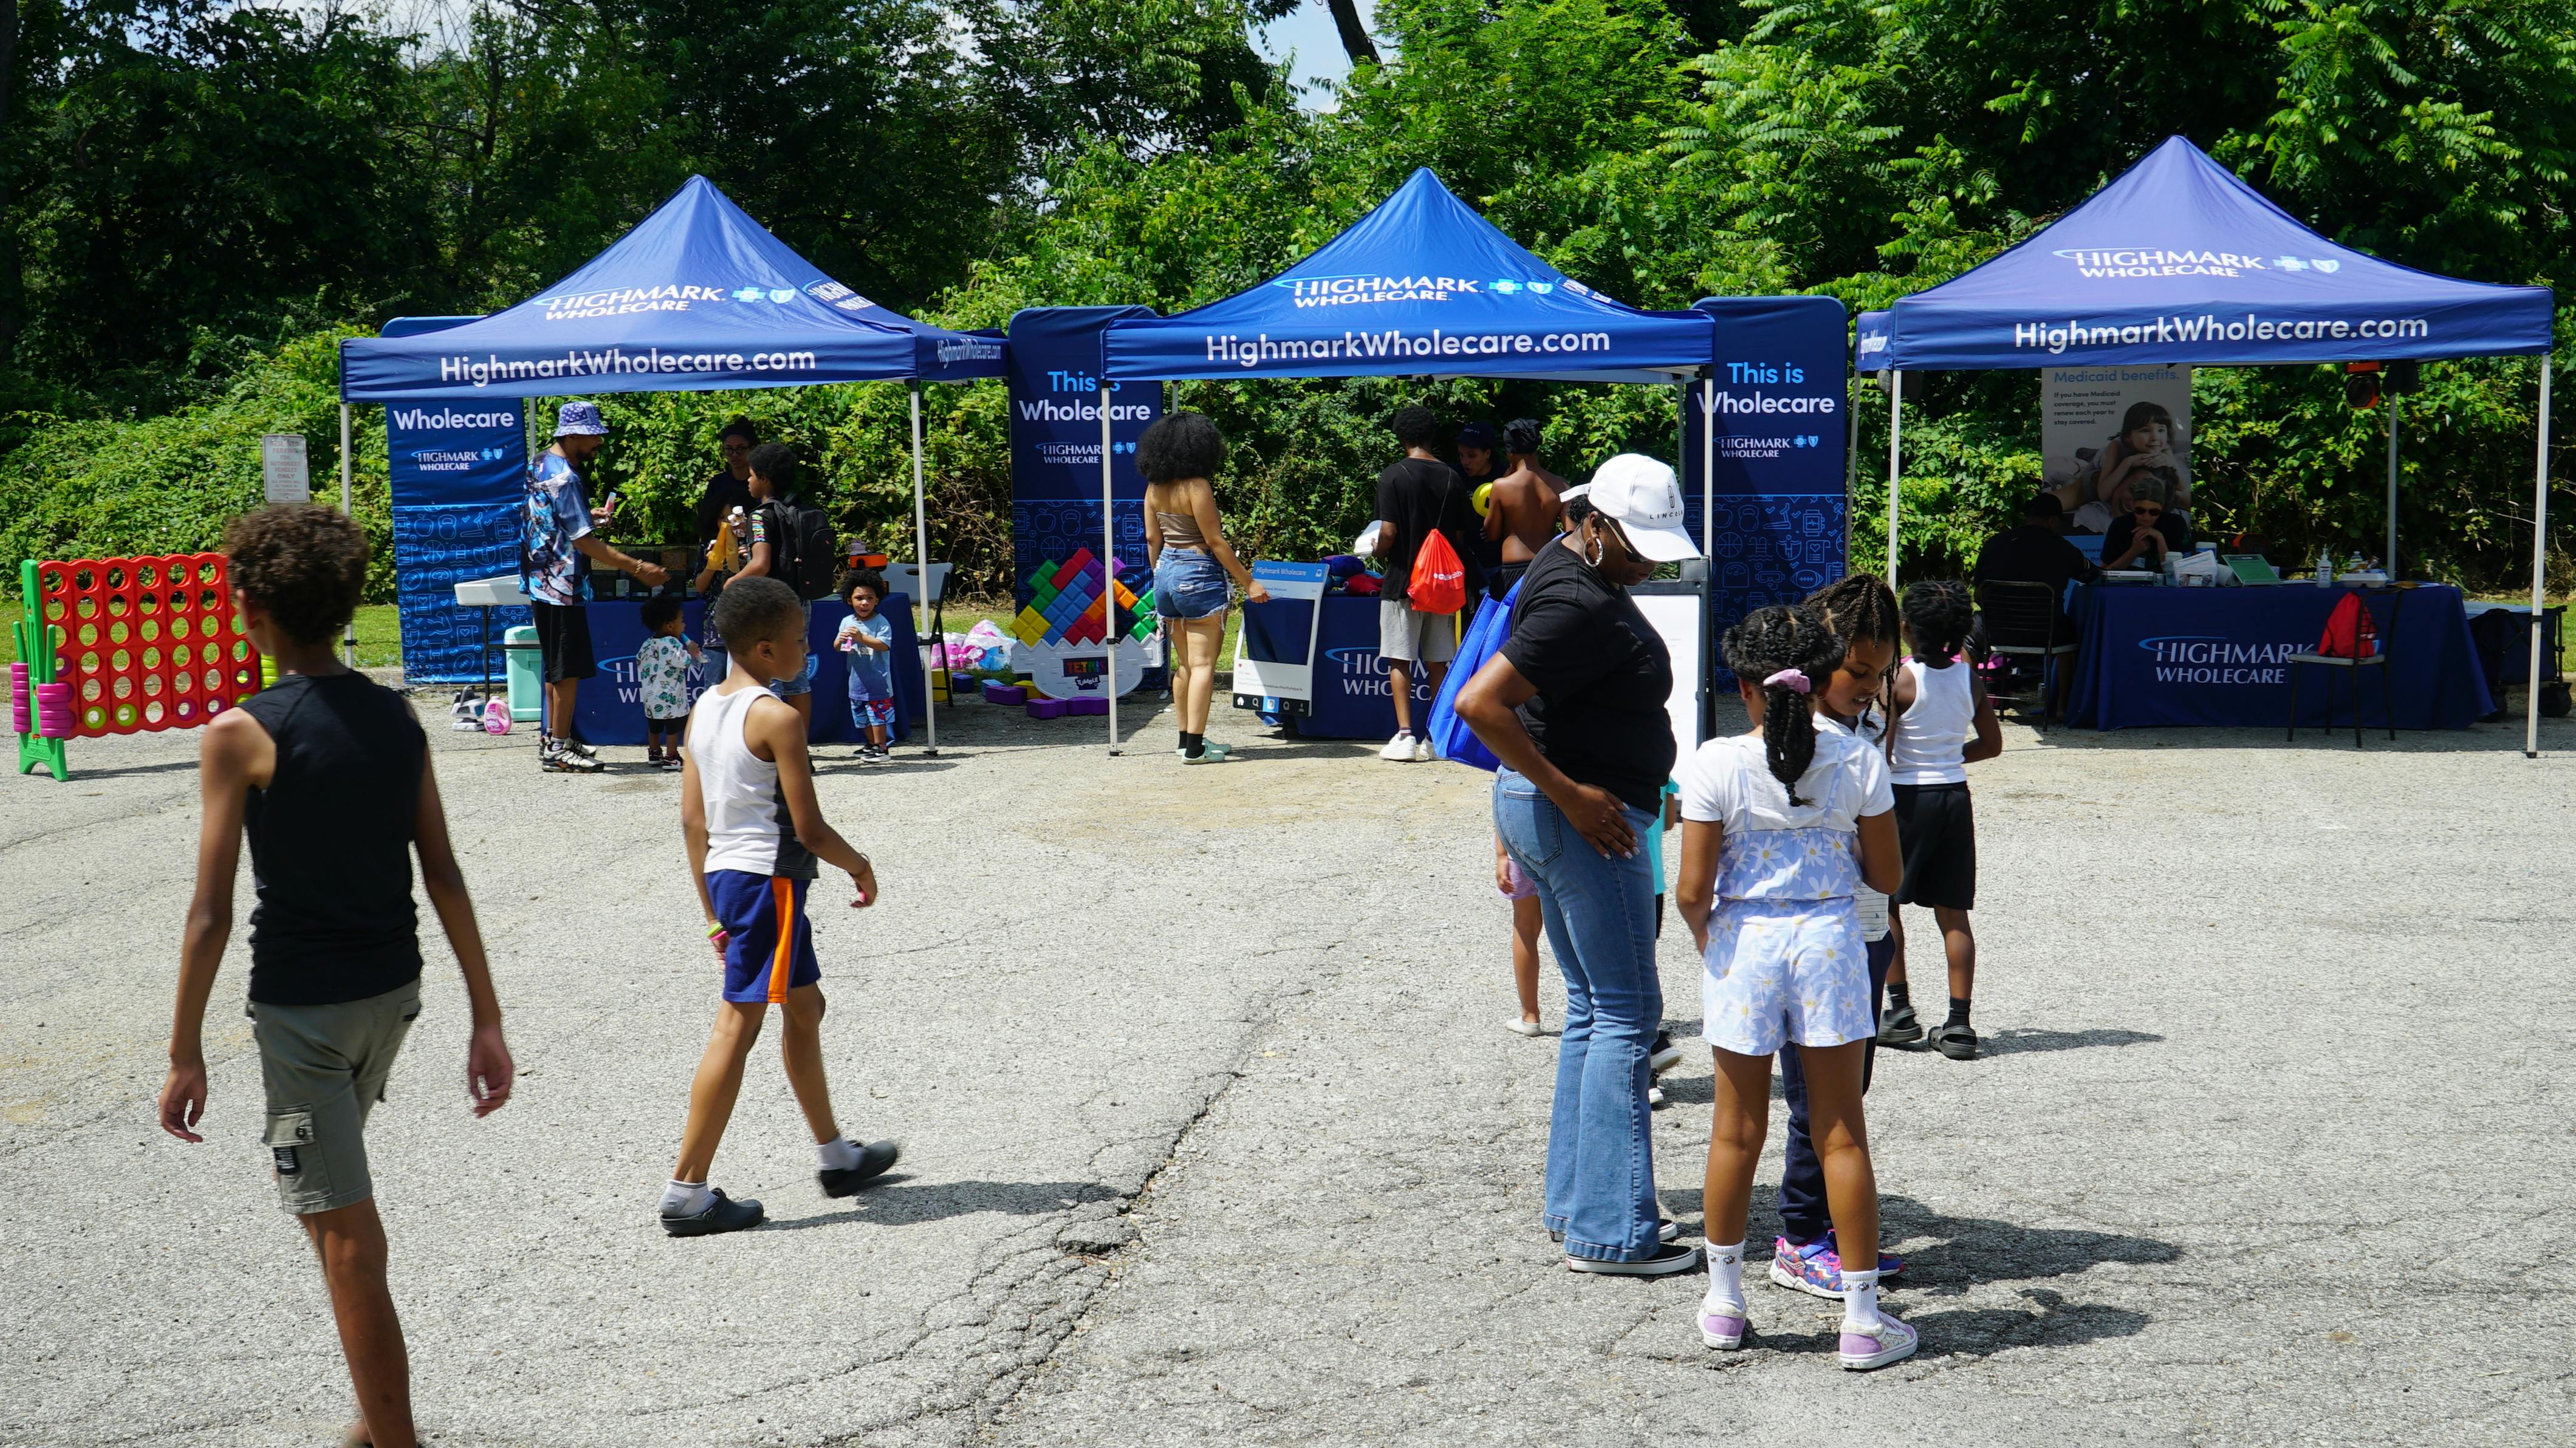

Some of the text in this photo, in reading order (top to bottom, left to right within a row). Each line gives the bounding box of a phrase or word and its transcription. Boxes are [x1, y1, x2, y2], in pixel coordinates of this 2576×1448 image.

[2075, 250, 2265, 269] HIGHMARK
[2080, 265, 2239, 278] WHOLECARE
[1295, 276, 1479, 296] HIGHMARK
[549, 284, 724, 311] HIGHMARK
[1295, 290, 1448, 308] WHOLECARE
[546, 300, 690, 320] WHOLECARE
[2015, 315, 2428, 354] HighmarkWholecare.com
[1207, 330, 1610, 367] HighmarkWholecare.com
[440, 347, 815, 388] HighmarkWholecare.com
[1727, 361, 1804, 383] This is
[2054, 369, 2180, 383] Medicaid benefits.
[1047, 371, 1096, 392] This
[1019, 399, 1151, 421] Wholecare
[1696, 391, 1835, 414] Wholecare
[393, 408, 515, 430] Wholecare
[1043, 445, 1103, 455] HIGHMAR
[1721, 438, 1790, 448] HIGHMARK
[418, 452, 479, 462] HIGHMARK
[1722, 449, 1780, 458] WHOLECARE
[419, 463, 470, 471] WHOLECARE
[2156, 666, 2285, 684] WHOLECARE
